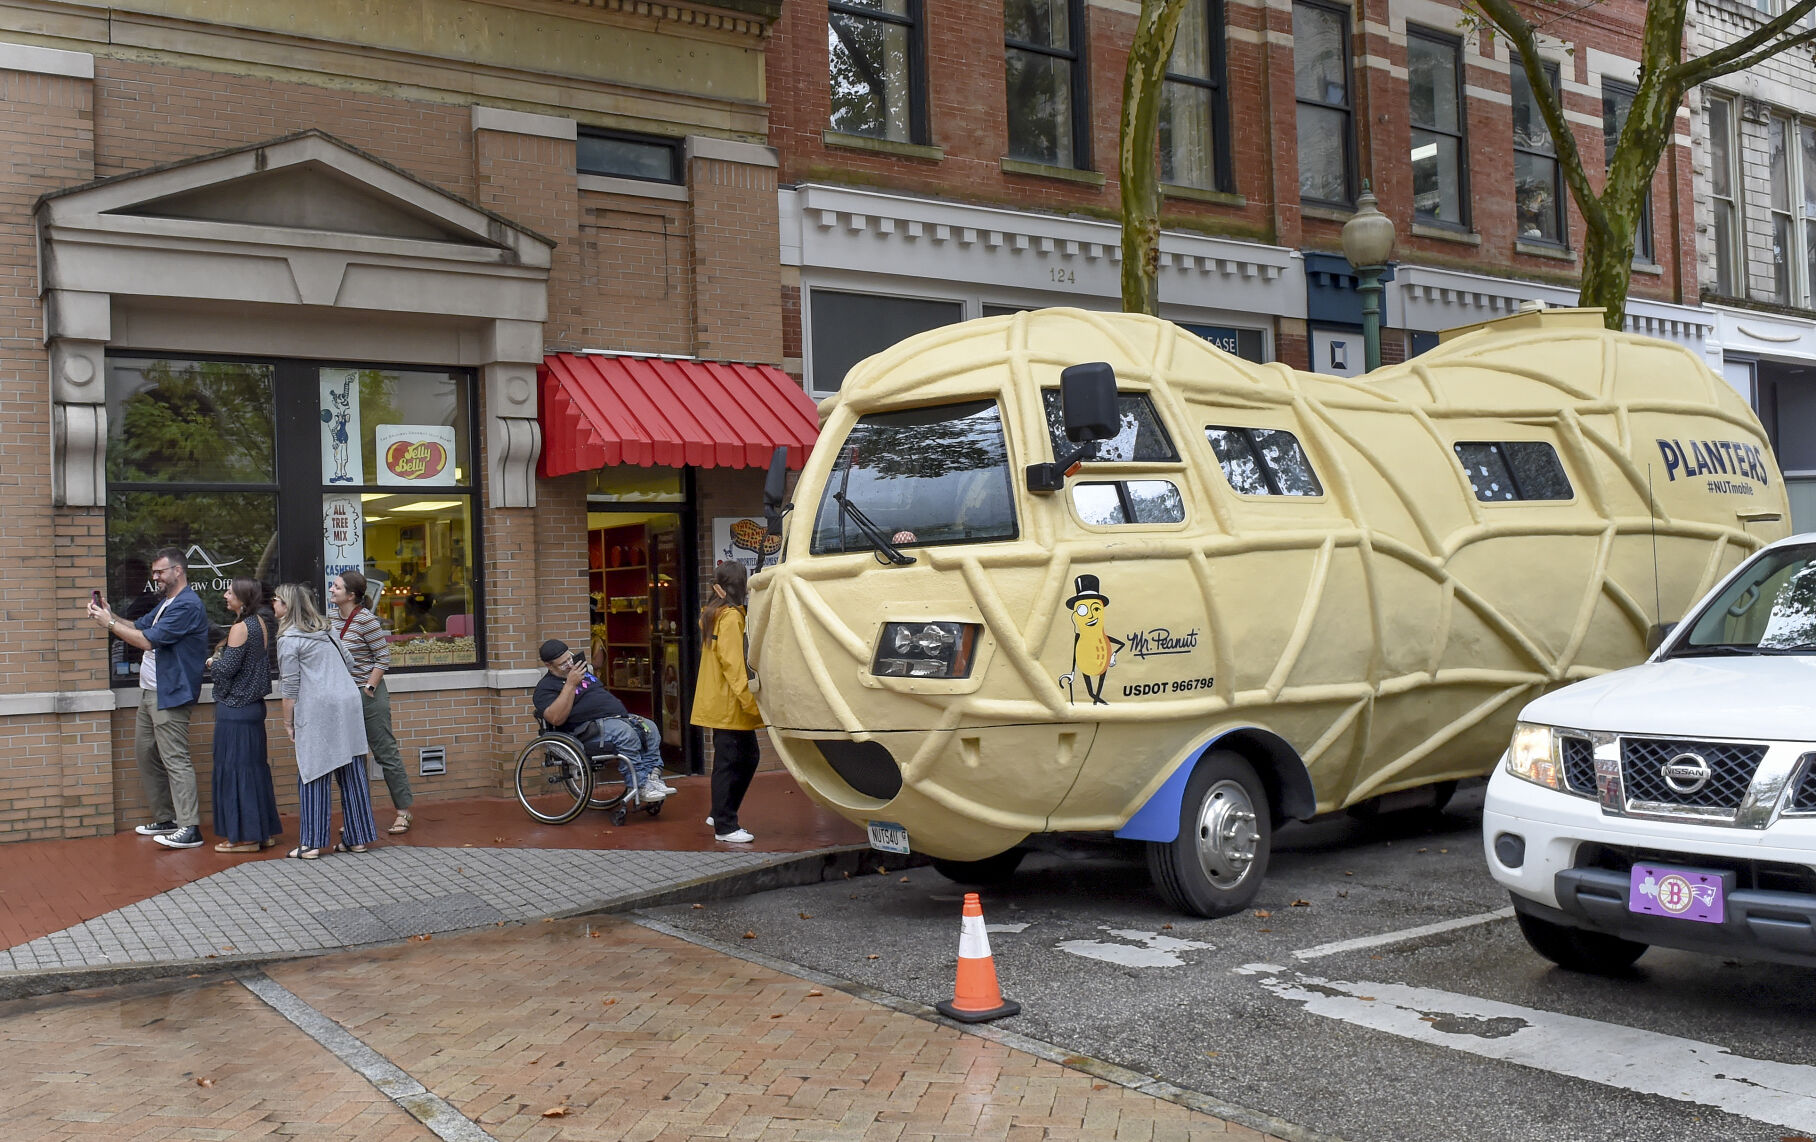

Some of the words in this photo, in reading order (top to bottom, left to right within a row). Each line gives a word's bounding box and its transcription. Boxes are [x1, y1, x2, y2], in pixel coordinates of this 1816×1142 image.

[1050, 267, 1075, 284] 124
[404, 440, 431, 462] Jelly
[395, 457, 426, 479] Belly
[1656, 439, 1768, 486] PLANTERS
[1707, 480, 1754, 495] #NUTmobile
[333, 505, 346, 515] ALL
[331, 518, 349, 529] TREE
[333, 530, 348, 542] MIX
[1126, 631, 1153, 660] Mr.
[1148, 628, 1199, 650] Peanut
[1123, 682, 1169, 697] USDOT
[1171, 677, 1214, 693] 966798
[1666, 767, 1704, 777] NISSAN
[872, 827, 899, 845] NUTS4U
